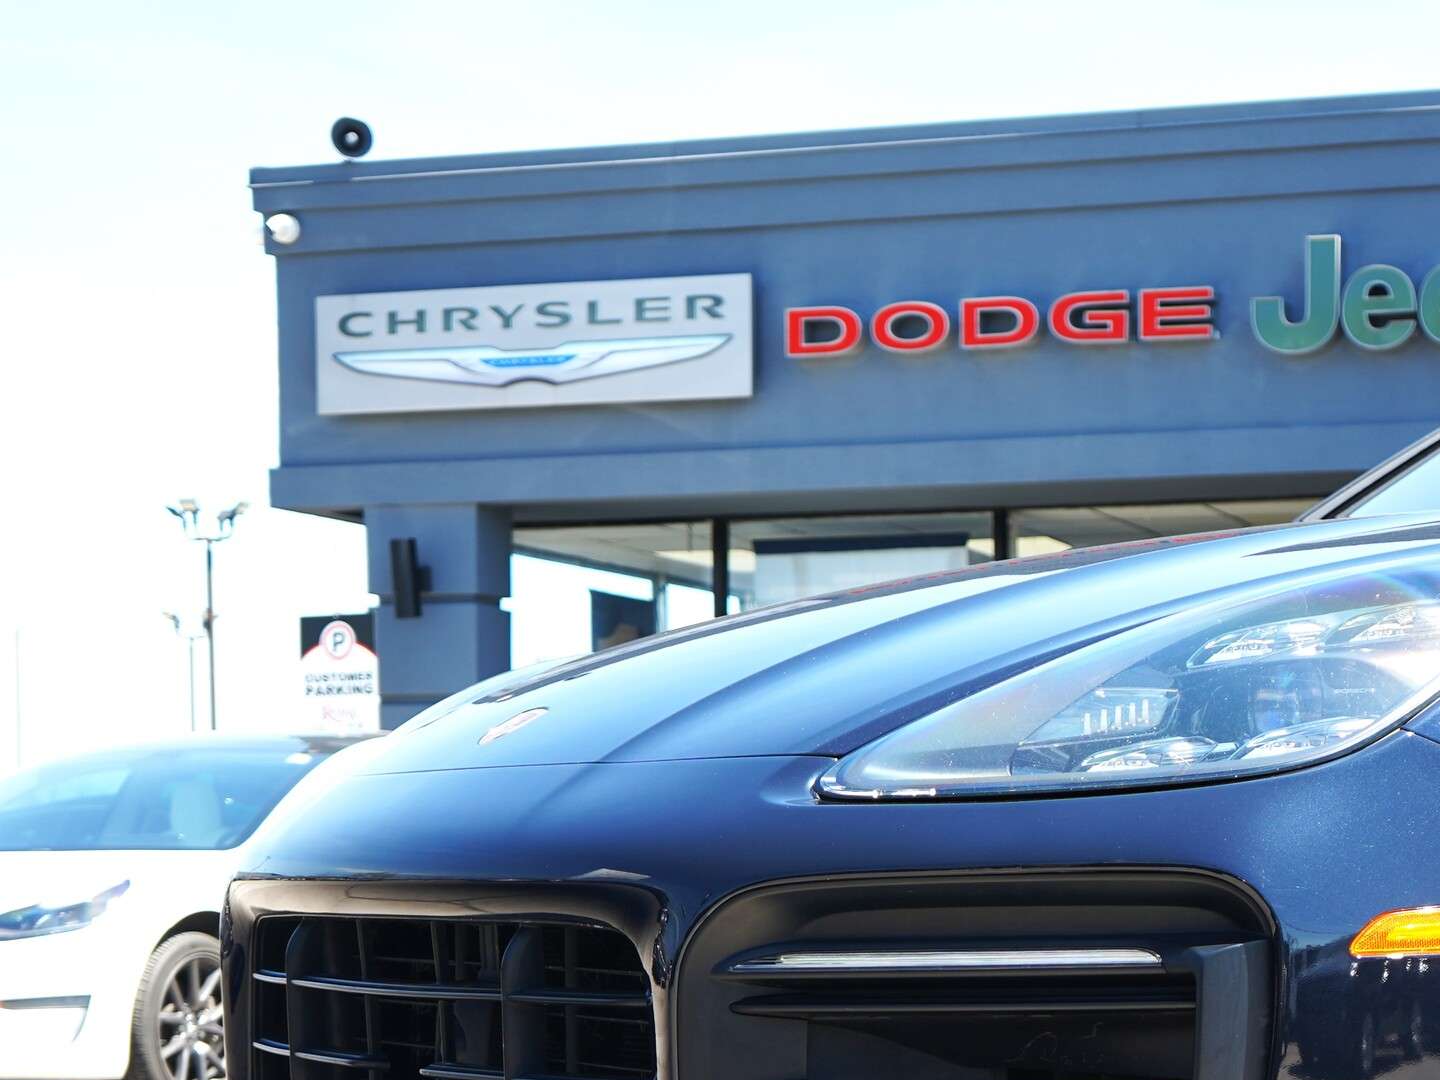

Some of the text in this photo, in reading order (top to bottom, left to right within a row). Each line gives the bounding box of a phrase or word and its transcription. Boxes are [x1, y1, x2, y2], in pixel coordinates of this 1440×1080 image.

[337, 293, 727, 338] CHRYSLER
[784, 286, 1215, 359] DODGE
[304, 684, 373, 697] PARKING
